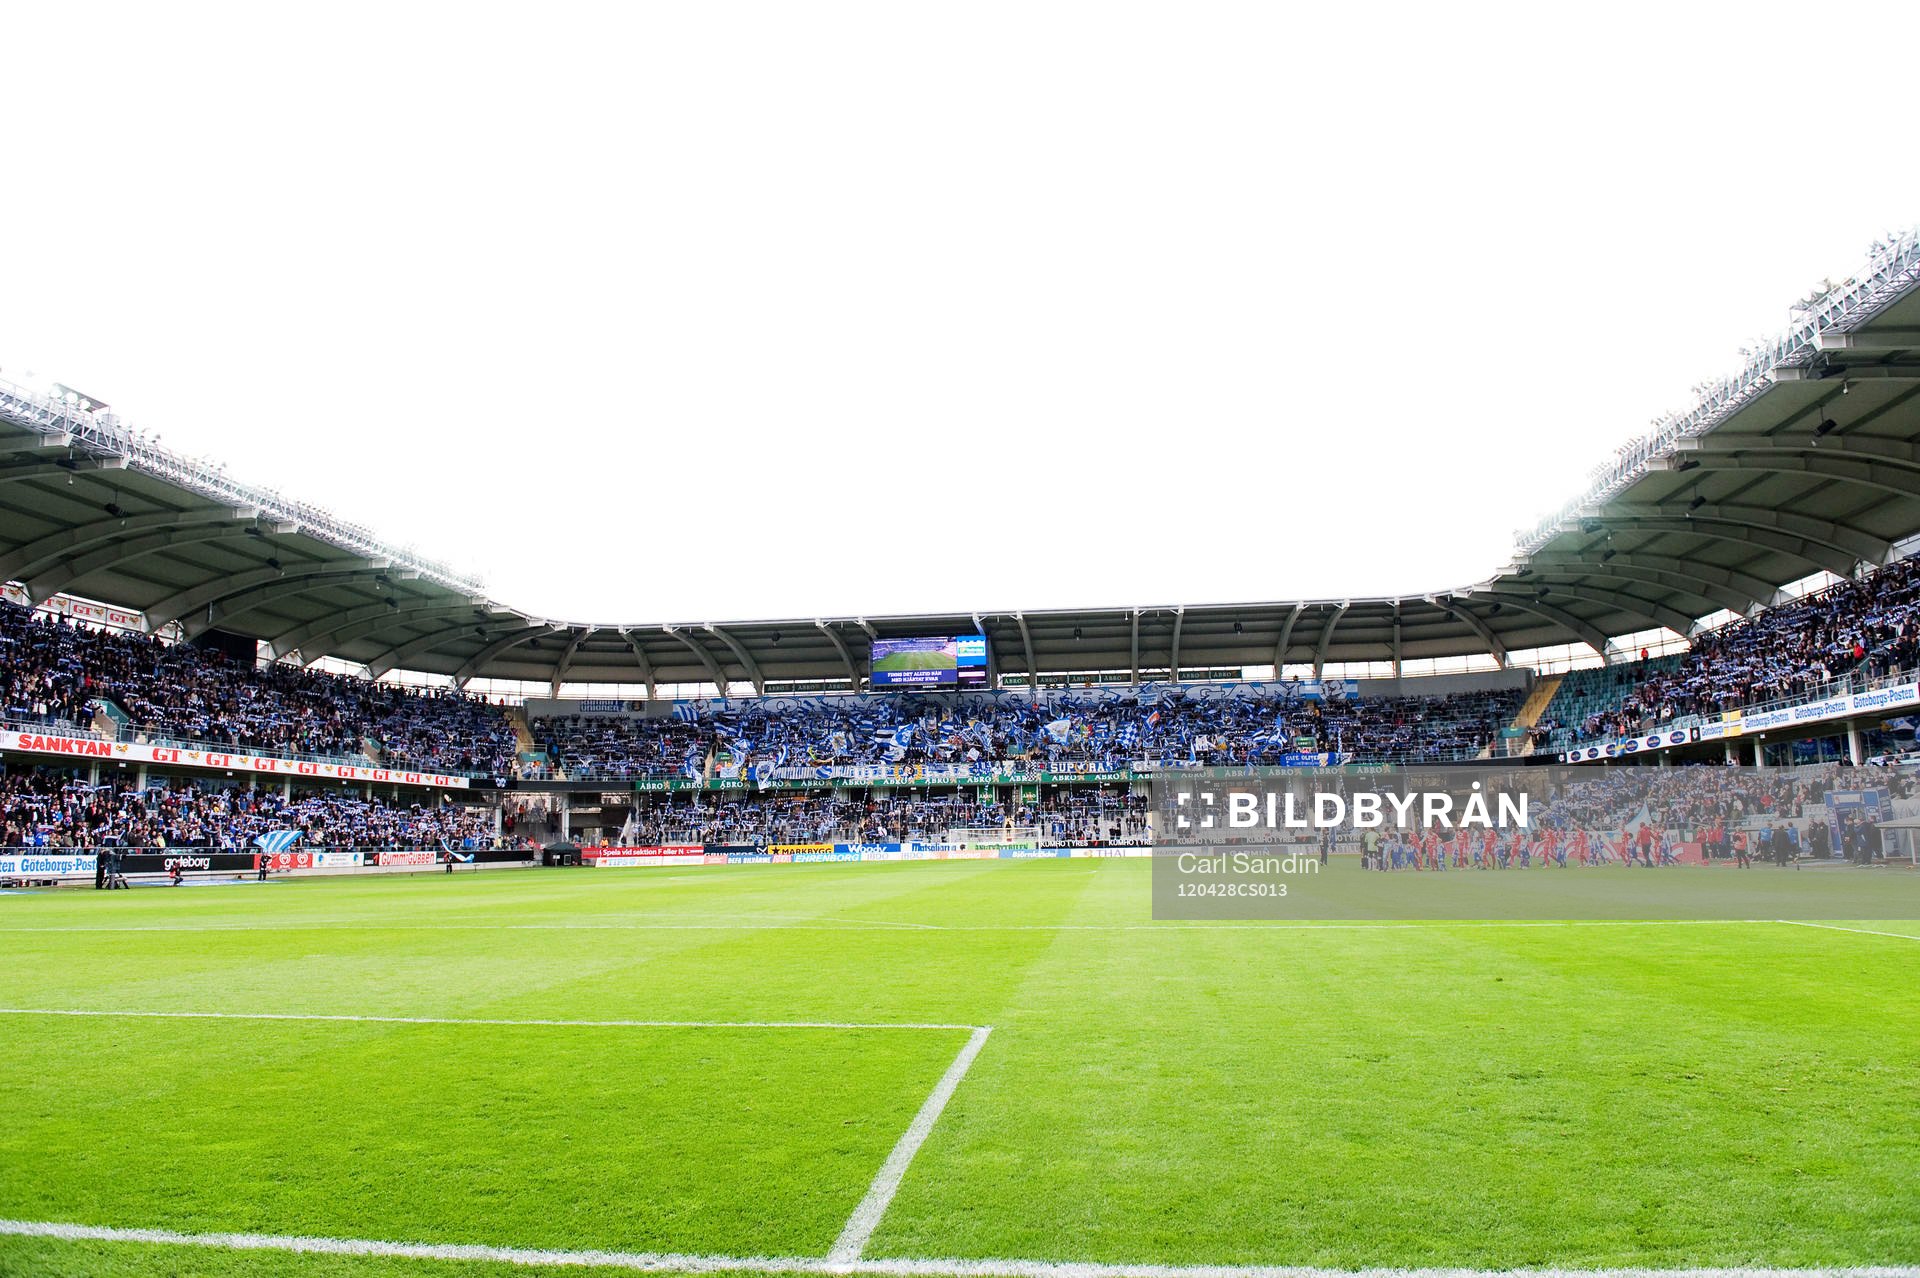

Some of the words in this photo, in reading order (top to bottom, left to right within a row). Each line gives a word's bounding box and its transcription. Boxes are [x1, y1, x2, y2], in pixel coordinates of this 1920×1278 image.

[73, 604, 92, 616] GT
[110, 613, 128, 625] GT
[18, 734, 112, 757] SANKTAN
[152, 747, 182, 763] GT
[206, 753, 233, 767] GT
[254, 757, 278, 771] GT
[298, 761, 321, 775] GT
[337, 766, 358, 779] GT
[373, 769, 392, 781] GT
[405, 772, 422, 784] GT
[435, 775, 450, 786] GT
[603, 848, 621, 857] Spela
[632, 847, 657, 855] sektion
[848, 844, 887, 852] Woody
[795, 853, 860, 862] EHRENBORG
